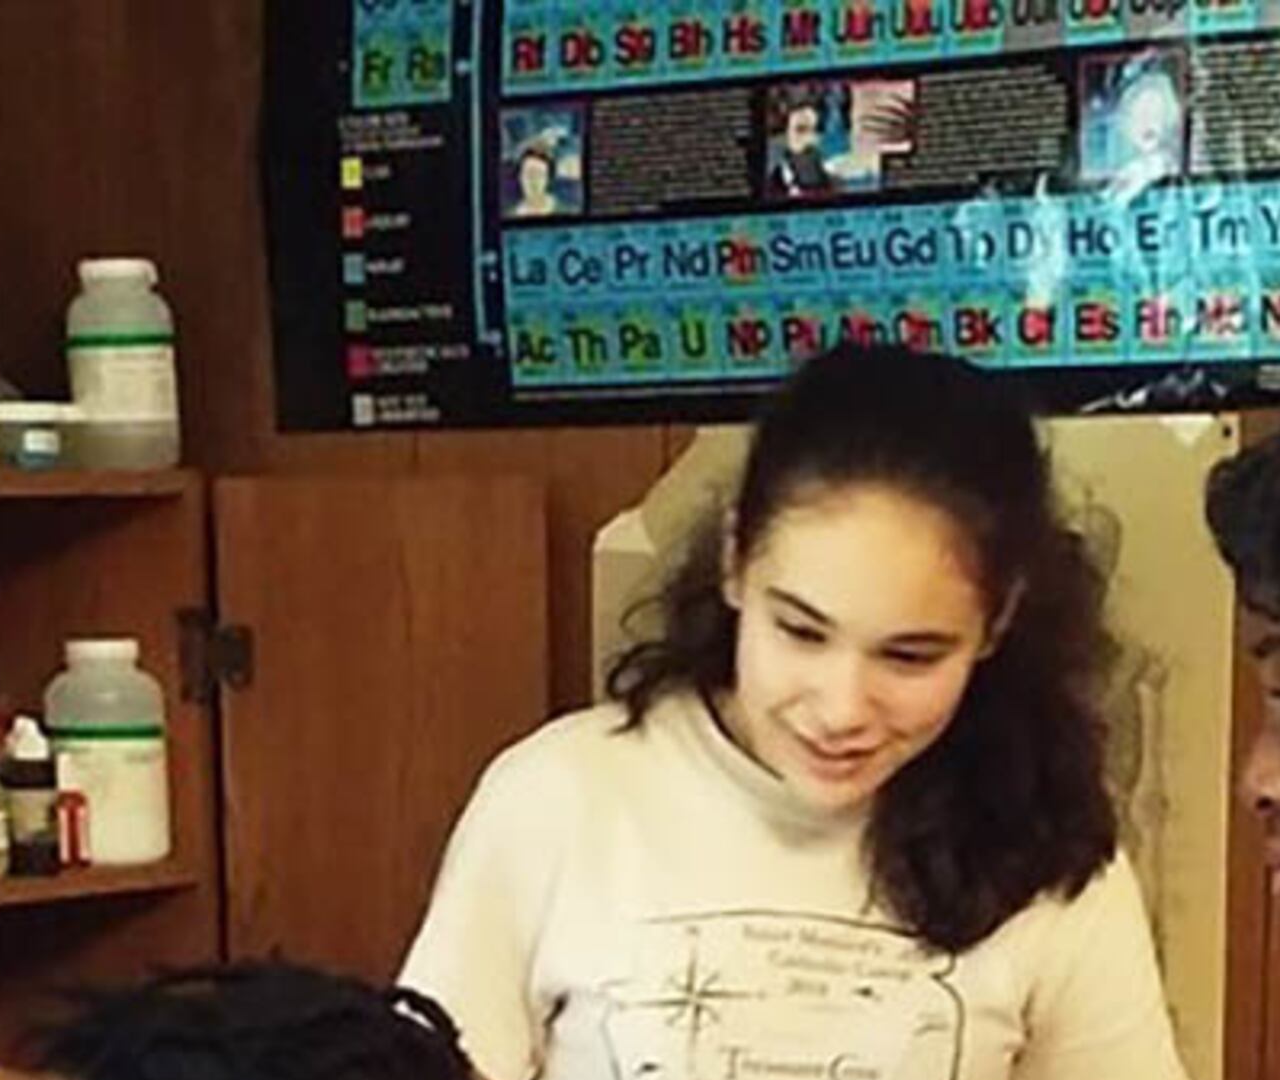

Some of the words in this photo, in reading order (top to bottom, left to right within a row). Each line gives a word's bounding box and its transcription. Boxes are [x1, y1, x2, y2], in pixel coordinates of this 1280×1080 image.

[509, 251, 547, 286] La
[558, 247, 603, 286] Ce
[614, 243, 650, 282] Pr
[663, 240, 711, 279] Nd
[770, 232, 825, 273] Sm
[830, 230, 877, 271] Eu
[883, 226, 937, 267] Gd
[1193, 206, 1250, 250] Tm
[515, 326, 556, 364] Ac
[562, 325, 609, 363] Th
[619, 321, 663, 360] Pa
[680, 319, 706, 358] U
[954, 306, 1002, 348] Bk
[1074, 299, 1120, 343] Es
